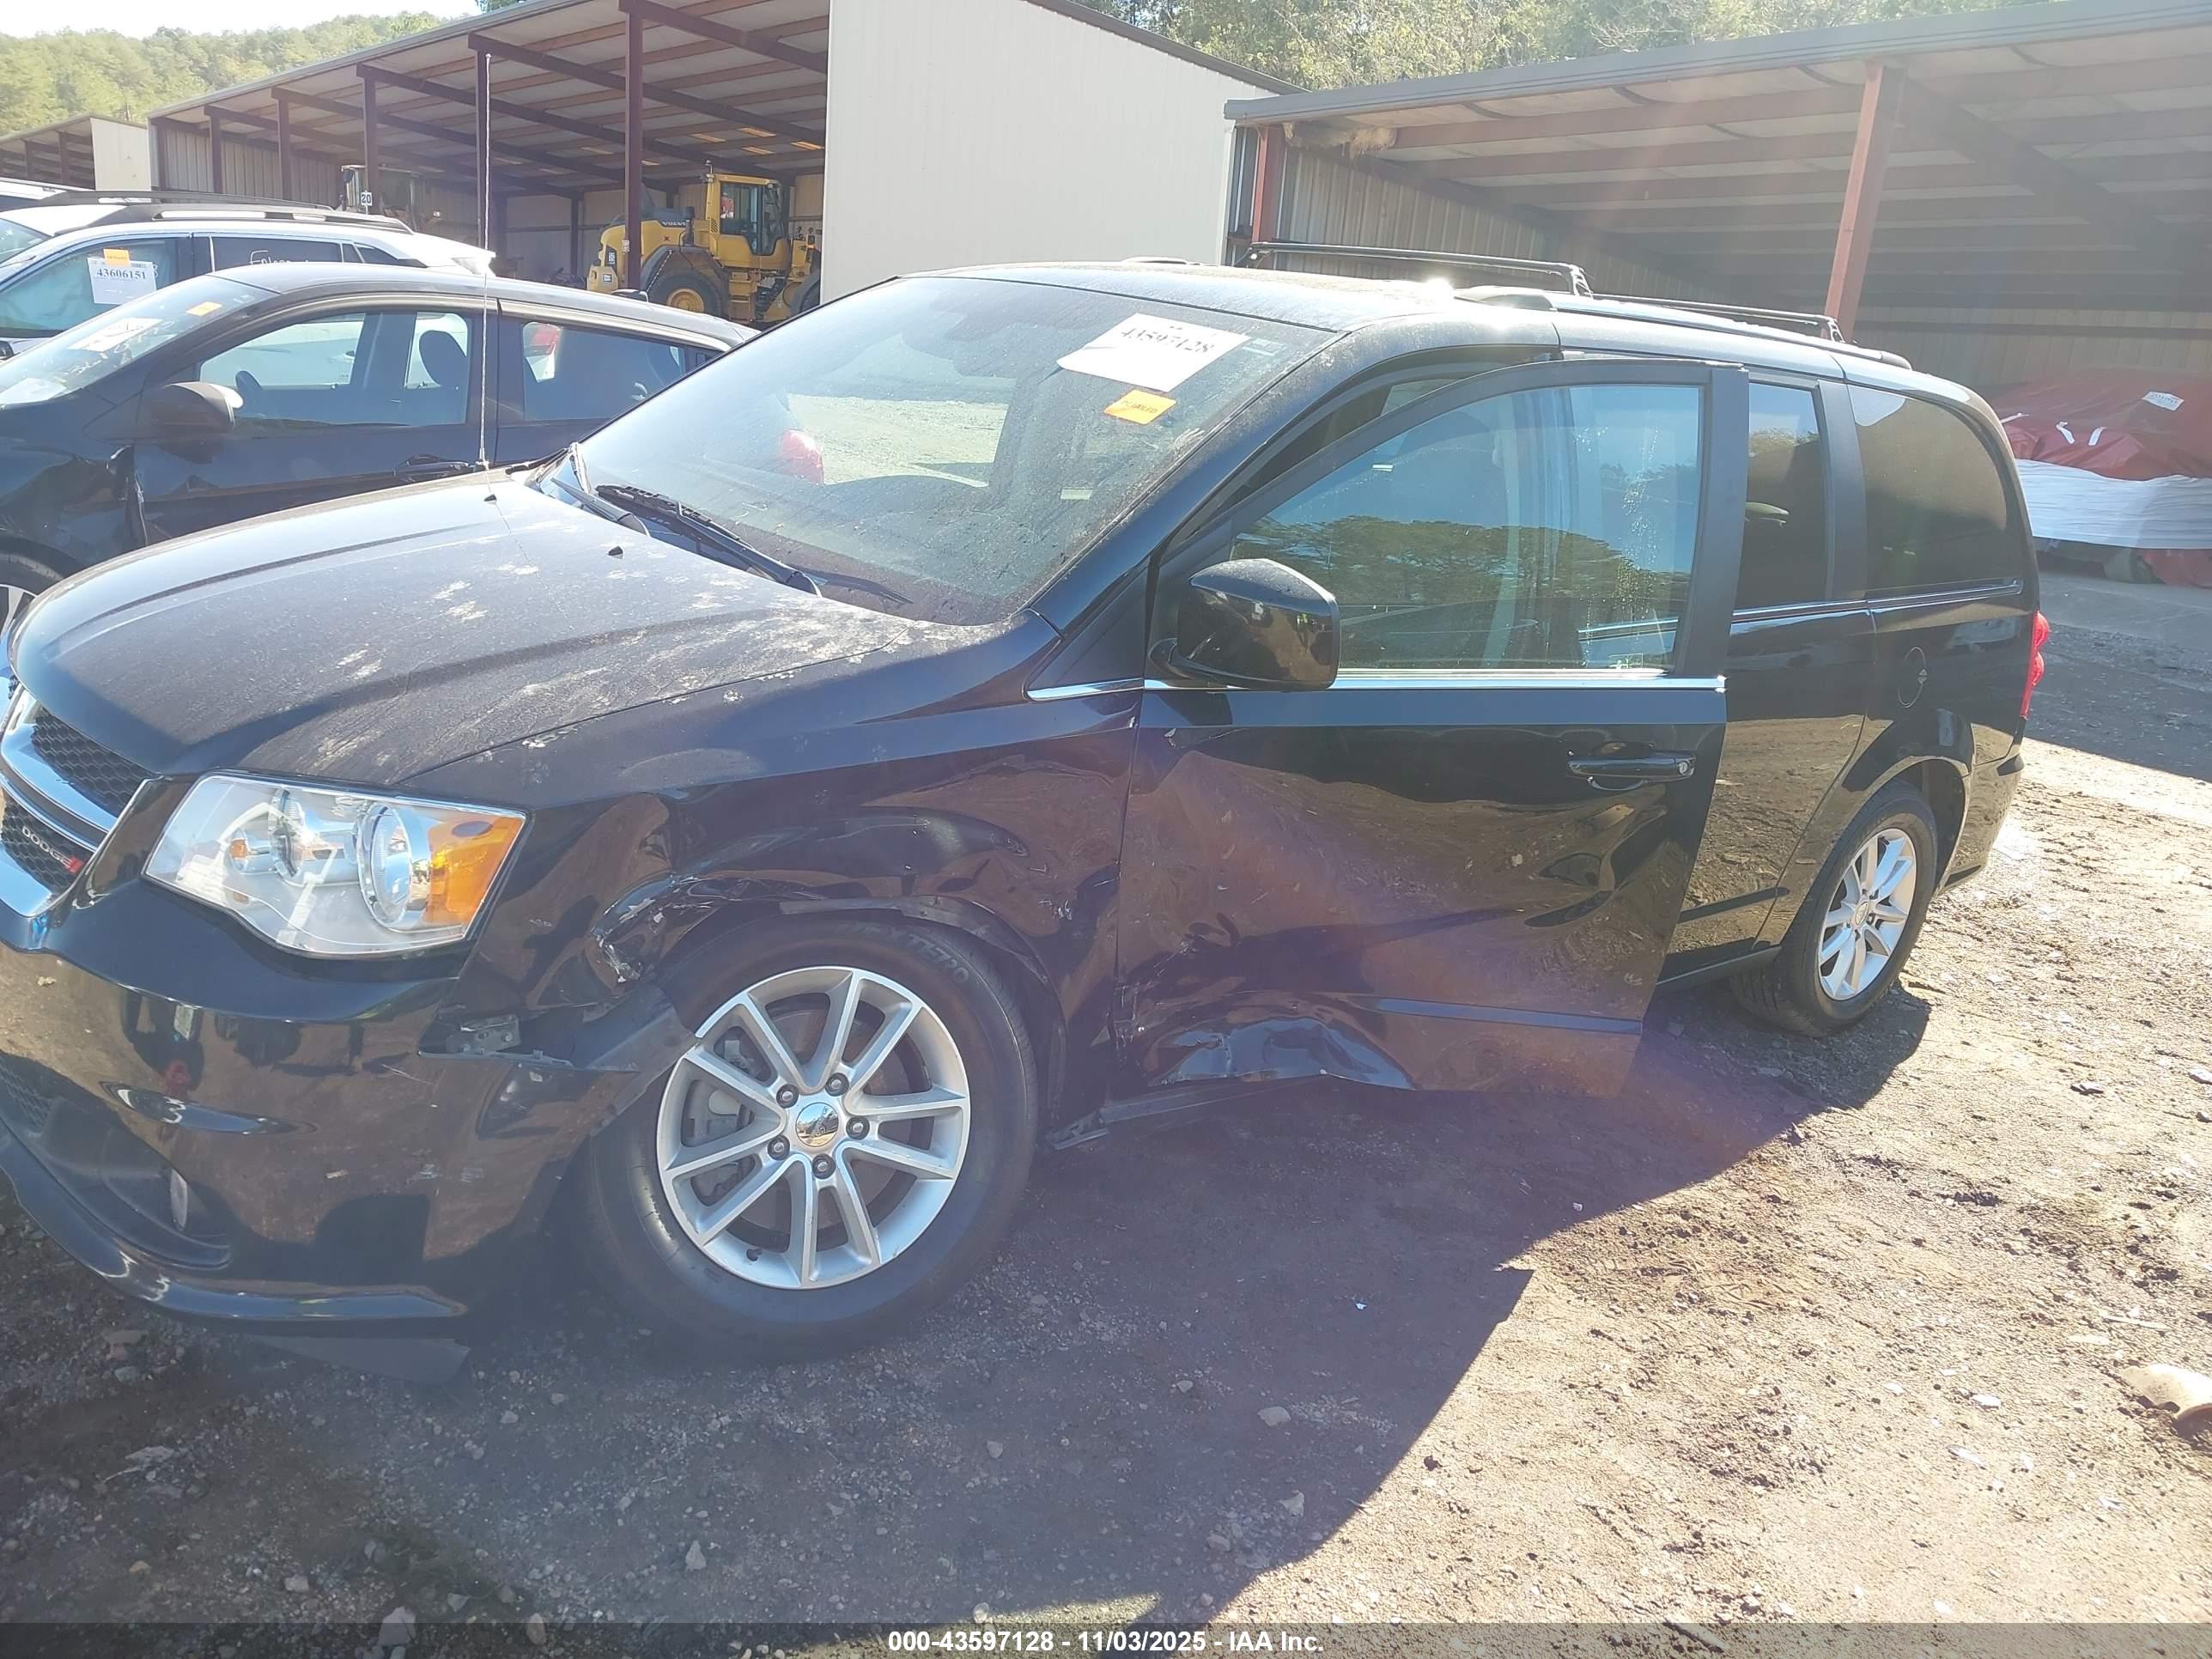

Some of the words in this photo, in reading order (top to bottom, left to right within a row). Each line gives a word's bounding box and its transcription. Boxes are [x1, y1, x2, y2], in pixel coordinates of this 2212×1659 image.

[361, 193, 372, 204] 20
[96, 268, 146, 280] 43606151
[21, 826, 71, 868] DODGE
